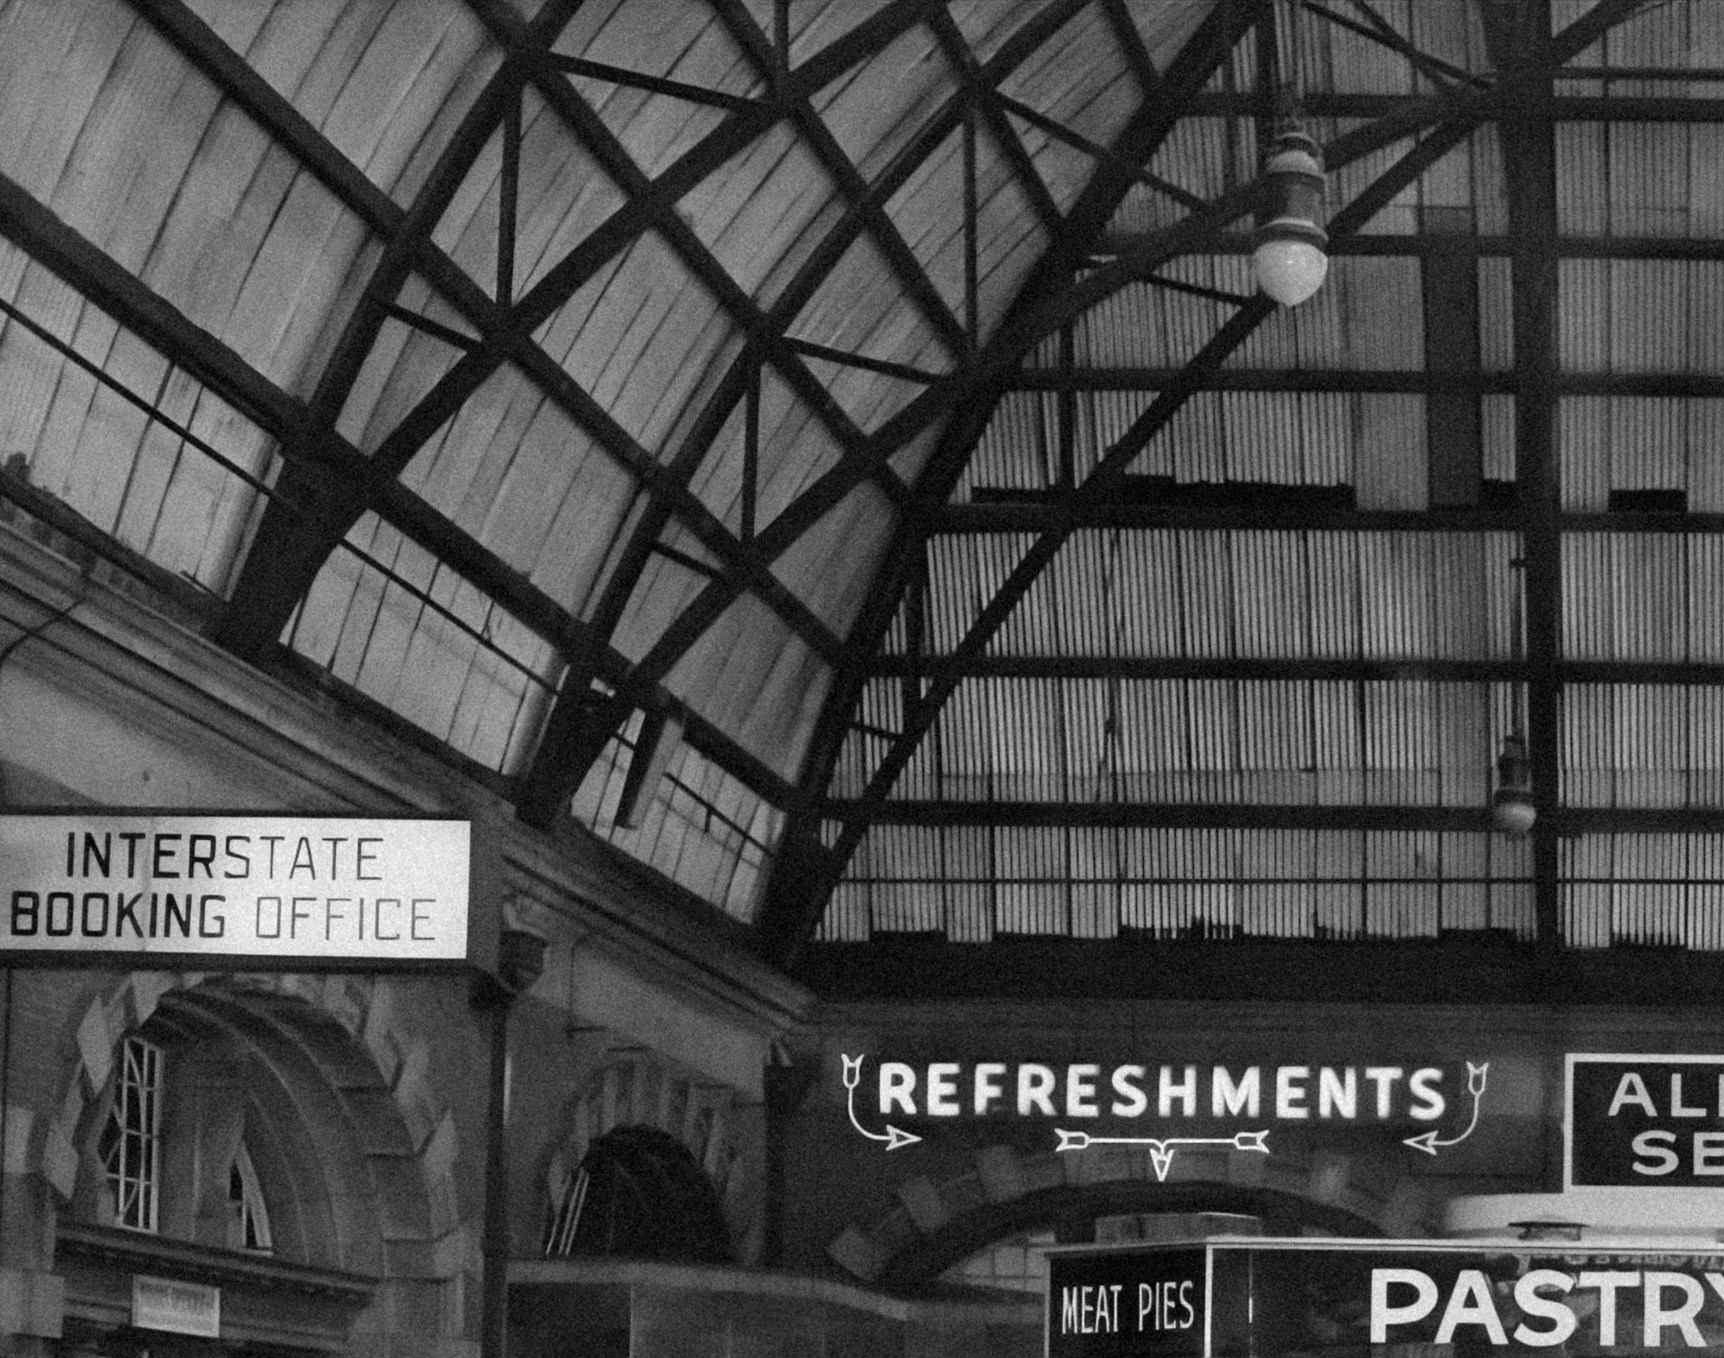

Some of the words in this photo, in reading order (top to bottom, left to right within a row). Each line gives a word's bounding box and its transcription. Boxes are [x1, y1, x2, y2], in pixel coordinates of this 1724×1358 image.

[66, 832, 384, 881] INTERSTATE
[10, 890, 227, 939] BOOKING
[256, 896, 437, 941] OFFICE
[878, 1062, 1447, 1120] REFRESHMENTS
[1062, 1284, 1123, 1335] MEAT
[1138, 1280, 1194, 1332] PIES
